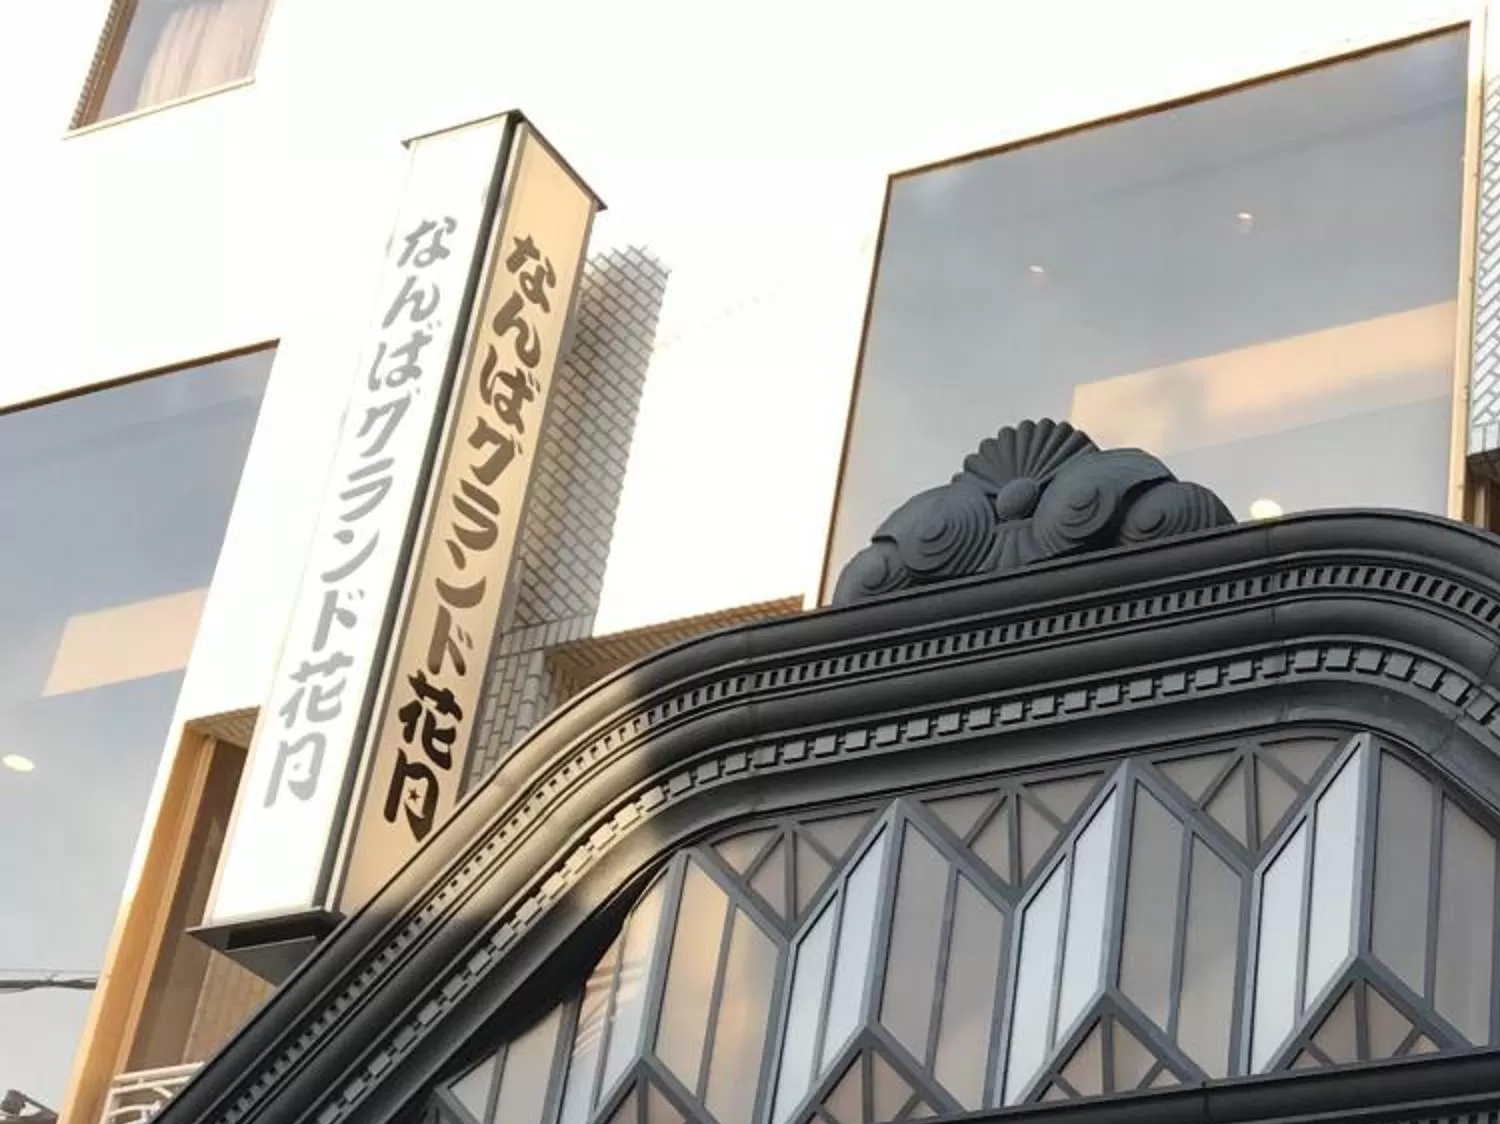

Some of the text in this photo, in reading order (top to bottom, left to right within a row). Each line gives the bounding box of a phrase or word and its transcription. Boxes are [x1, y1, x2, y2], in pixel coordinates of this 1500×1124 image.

[264, 216, 457, 808] なんばグランド花月
[383, 234, 557, 841] なんばグランド花月
